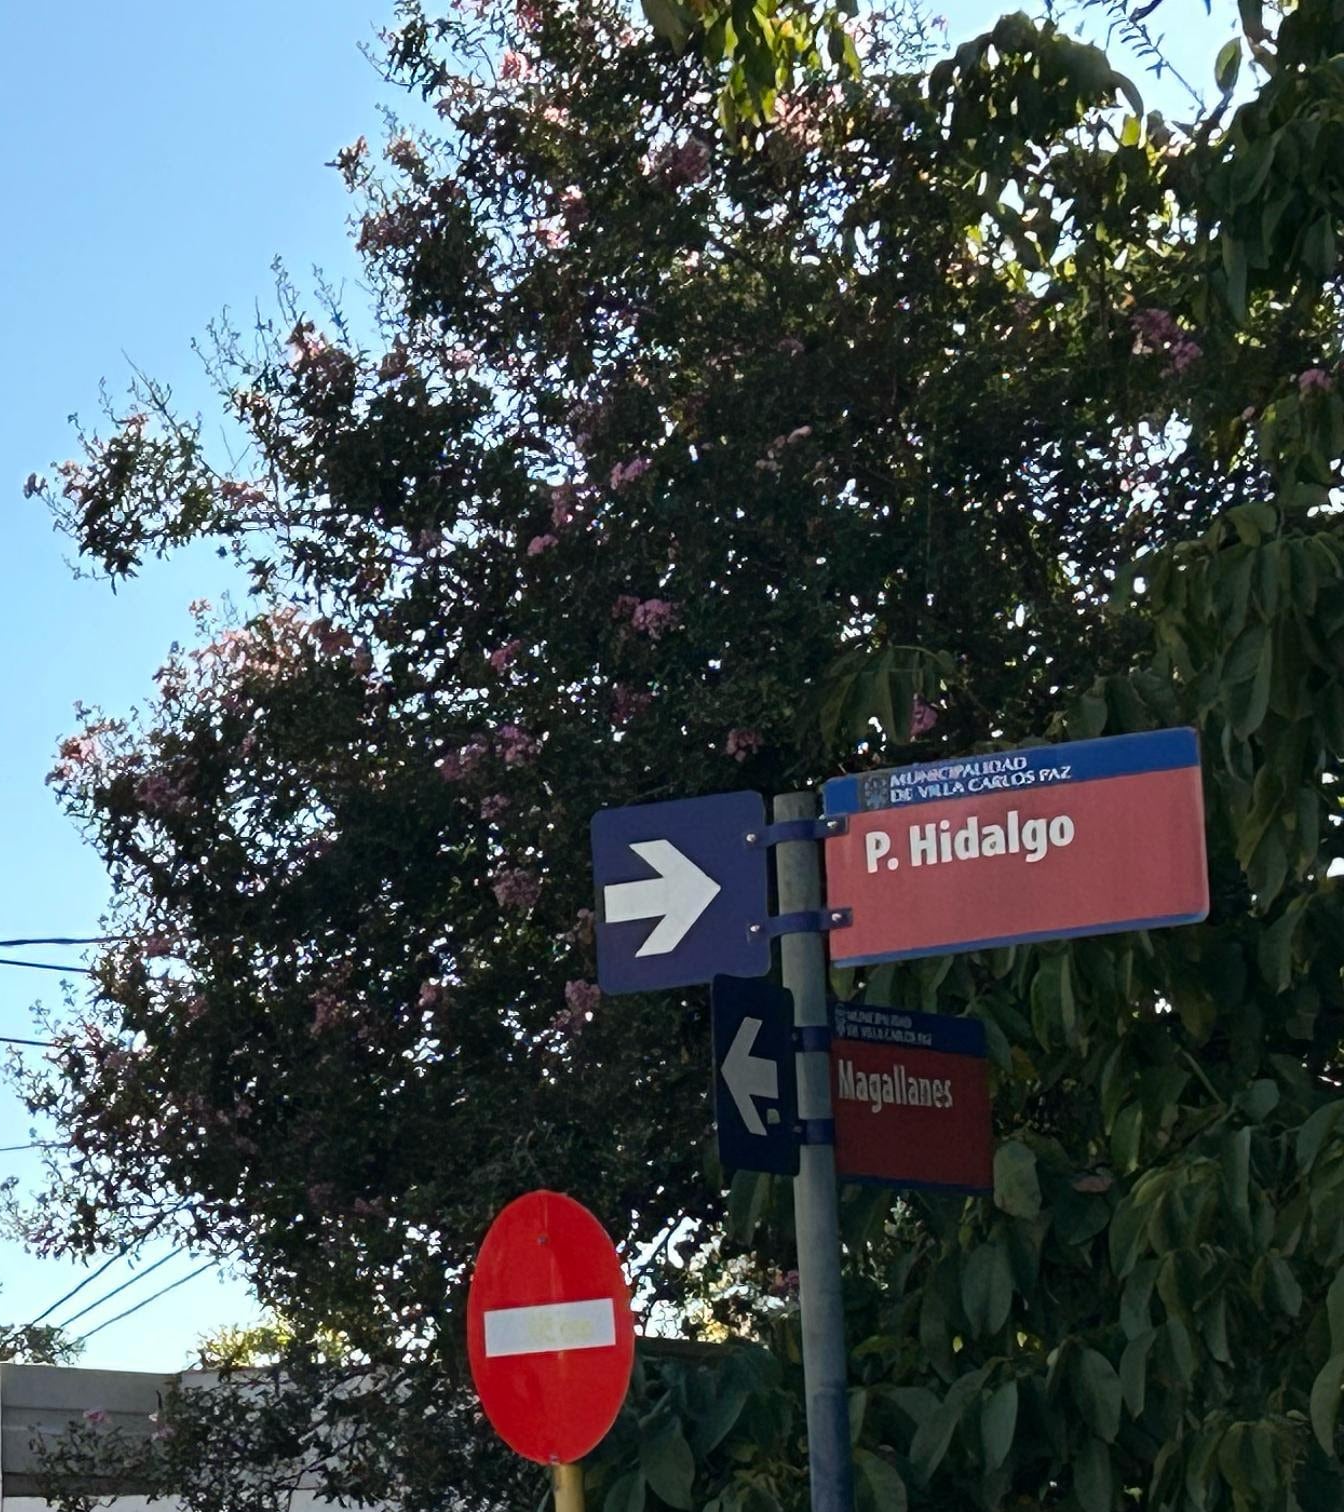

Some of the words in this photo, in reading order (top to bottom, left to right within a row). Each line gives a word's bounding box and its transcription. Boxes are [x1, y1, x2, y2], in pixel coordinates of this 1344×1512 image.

[890, 787, 912, 803] DE
[917, 781, 964, 799] VILLA
[968, 771, 1035, 791] CARLOS
[1039, 766, 1072, 782] PAZ
[865, 831, 899, 873] P.
[910, 810, 1075, 864] Hidalgo
[838, 1059, 952, 1113] Magallanes
